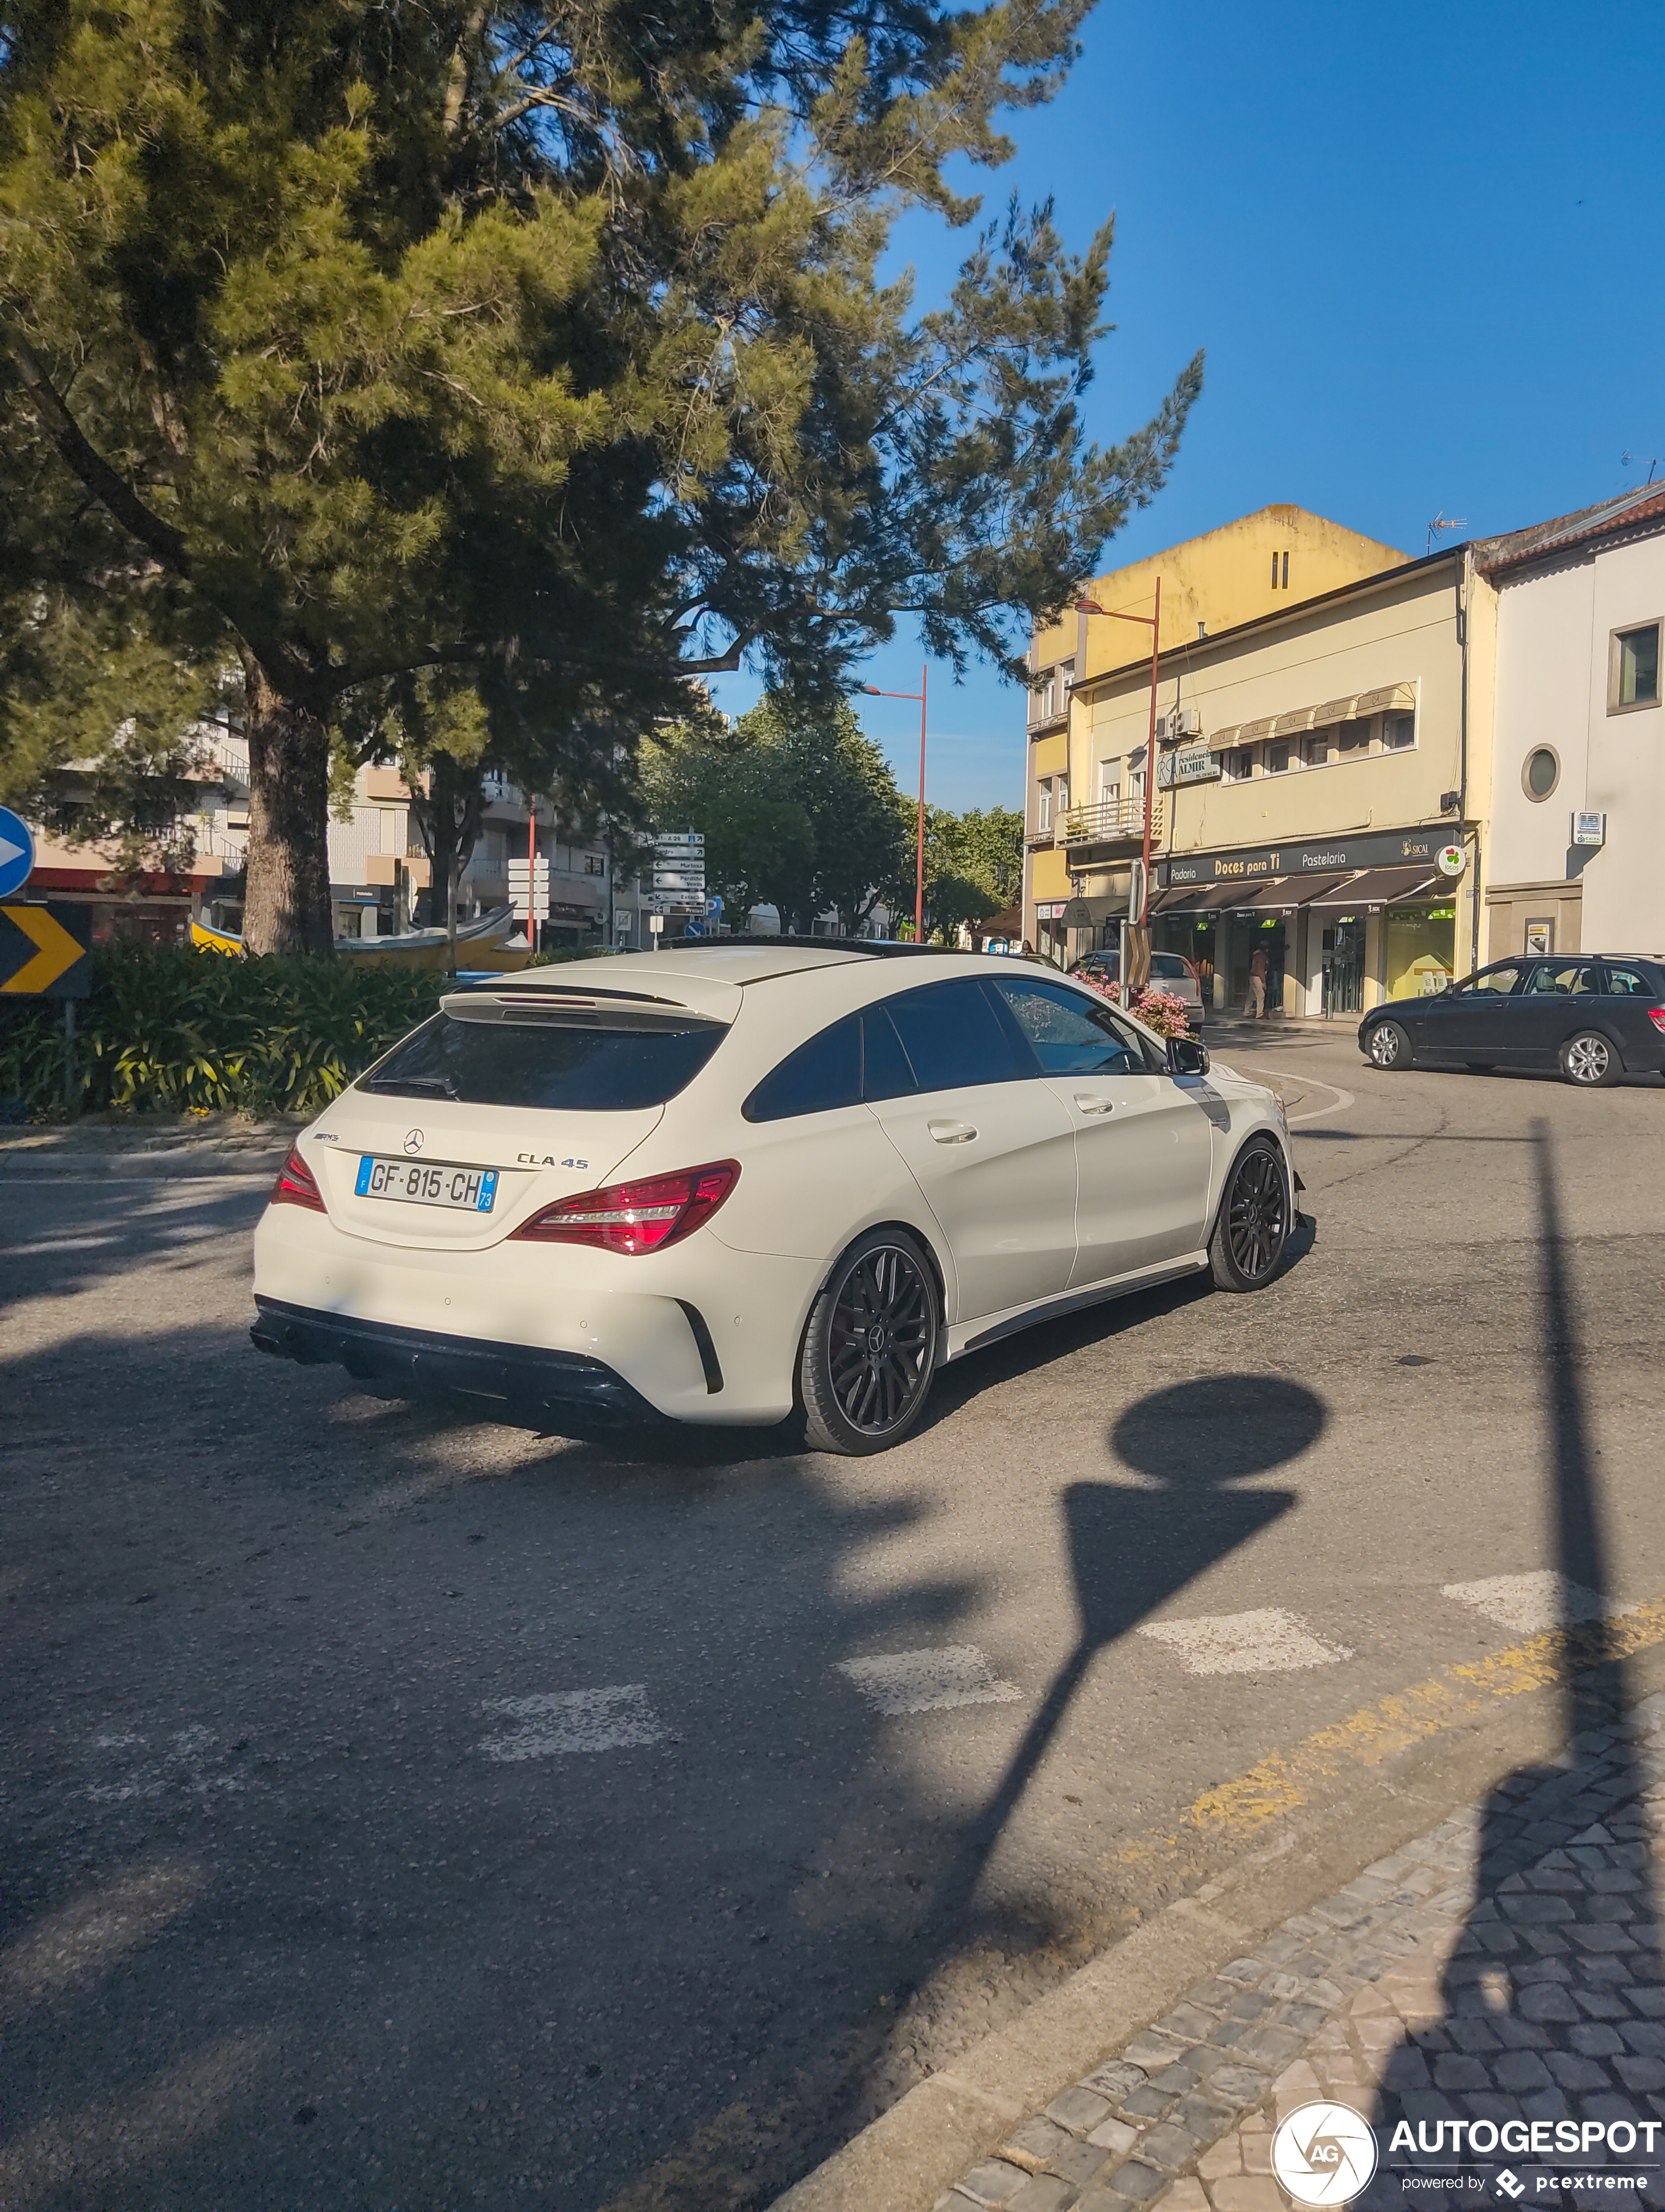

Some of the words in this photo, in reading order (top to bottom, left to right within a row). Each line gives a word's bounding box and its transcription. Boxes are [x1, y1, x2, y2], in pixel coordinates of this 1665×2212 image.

[1179, 760, 1205, 775] ALMIR
[1412, 844, 1429, 855] SICAL
[1215, 859, 1244, 876] Doces
[1247, 860, 1268, 876] para
[1270, 853, 1280, 870] Ti
[1303, 851, 1346, 867] Pastelaria
[1171, 868, 1196, 881] Padaria
[705, 899, 718, 916] P
[517, 1153, 556, 1167] CLA
[560, 1158, 589, 1170] 45
[361, 1180, 366, 1188] F
[479, 1192, 492, 1207] 73
